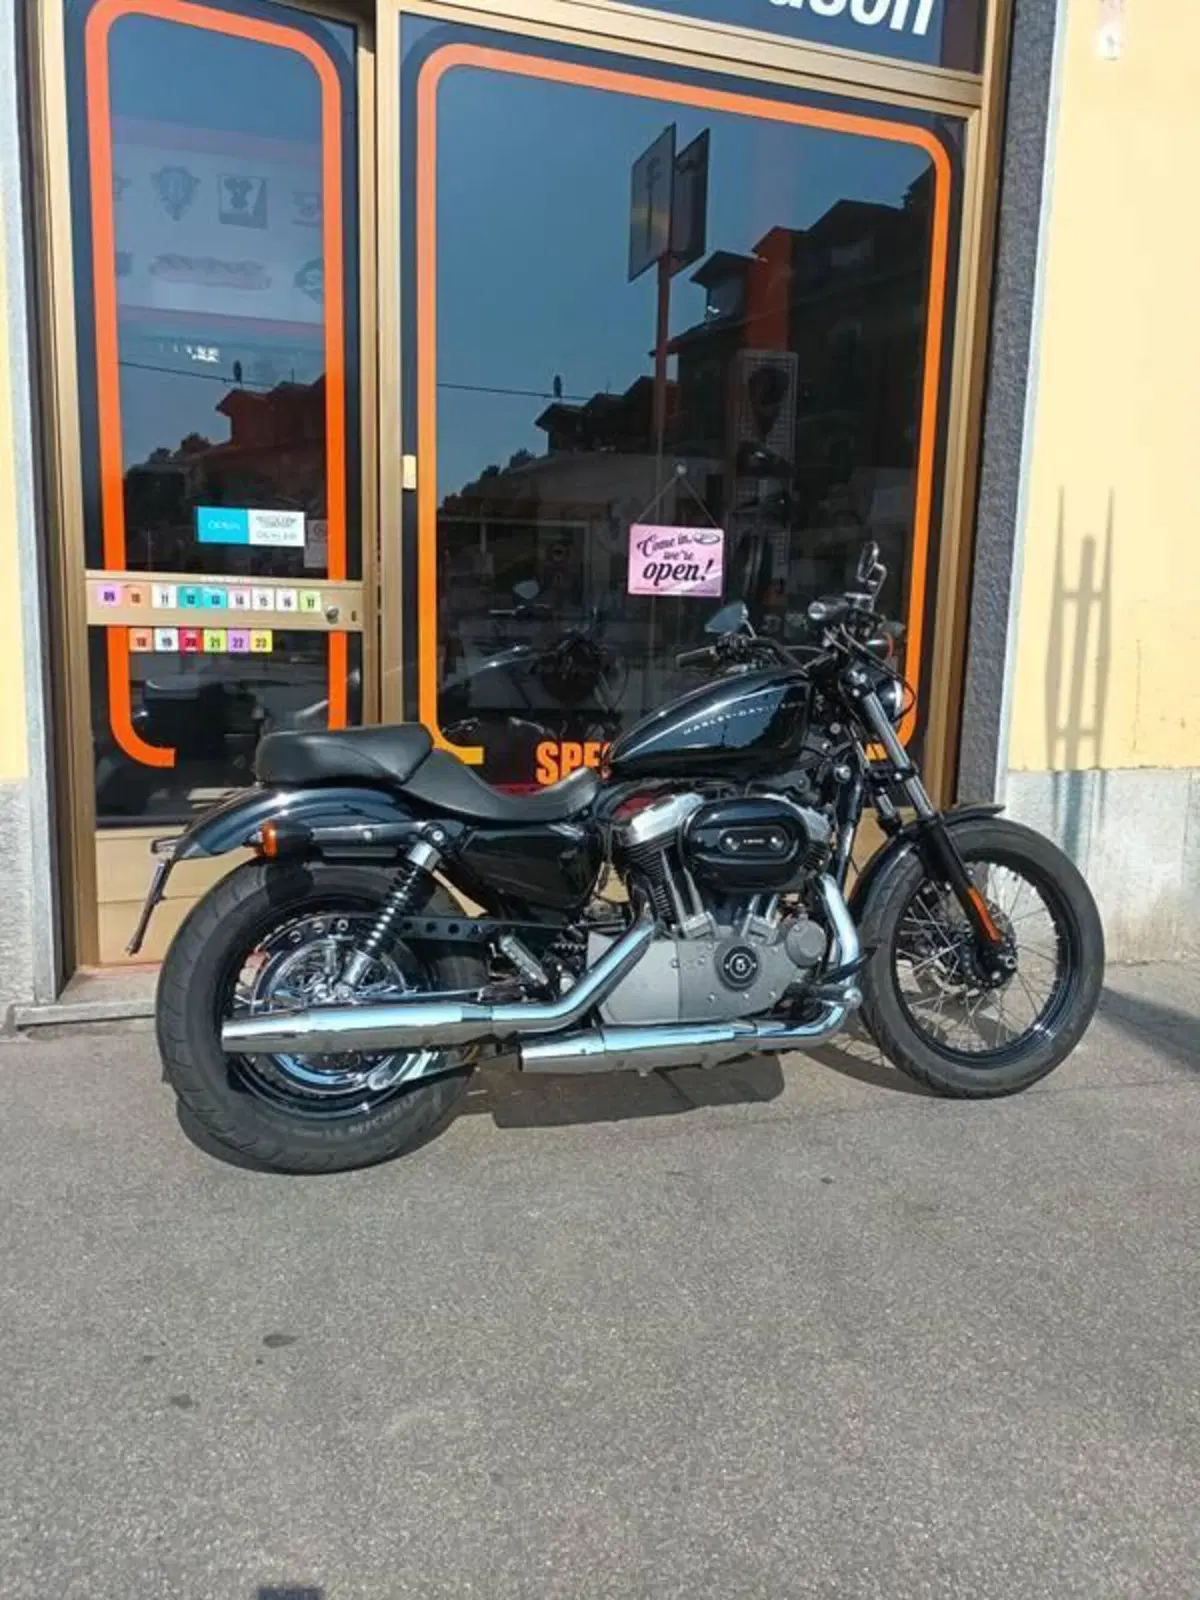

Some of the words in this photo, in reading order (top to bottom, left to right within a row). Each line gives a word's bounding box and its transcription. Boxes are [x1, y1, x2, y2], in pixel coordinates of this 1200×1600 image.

[768, 0, 934, 36] on
[637, 534, 676, 557] Come
[663, 549, 694, 561] we're
[642, 558, 714, 587] open!
[186, 594, 197, 605] 12
[235, 595, 245, 606] 14
[209, 636, 221, 648] 21
[233, 637, 244, 649] 22
[255, 637, 267, 648] 23
[536, 741, 610, 785] SPE
